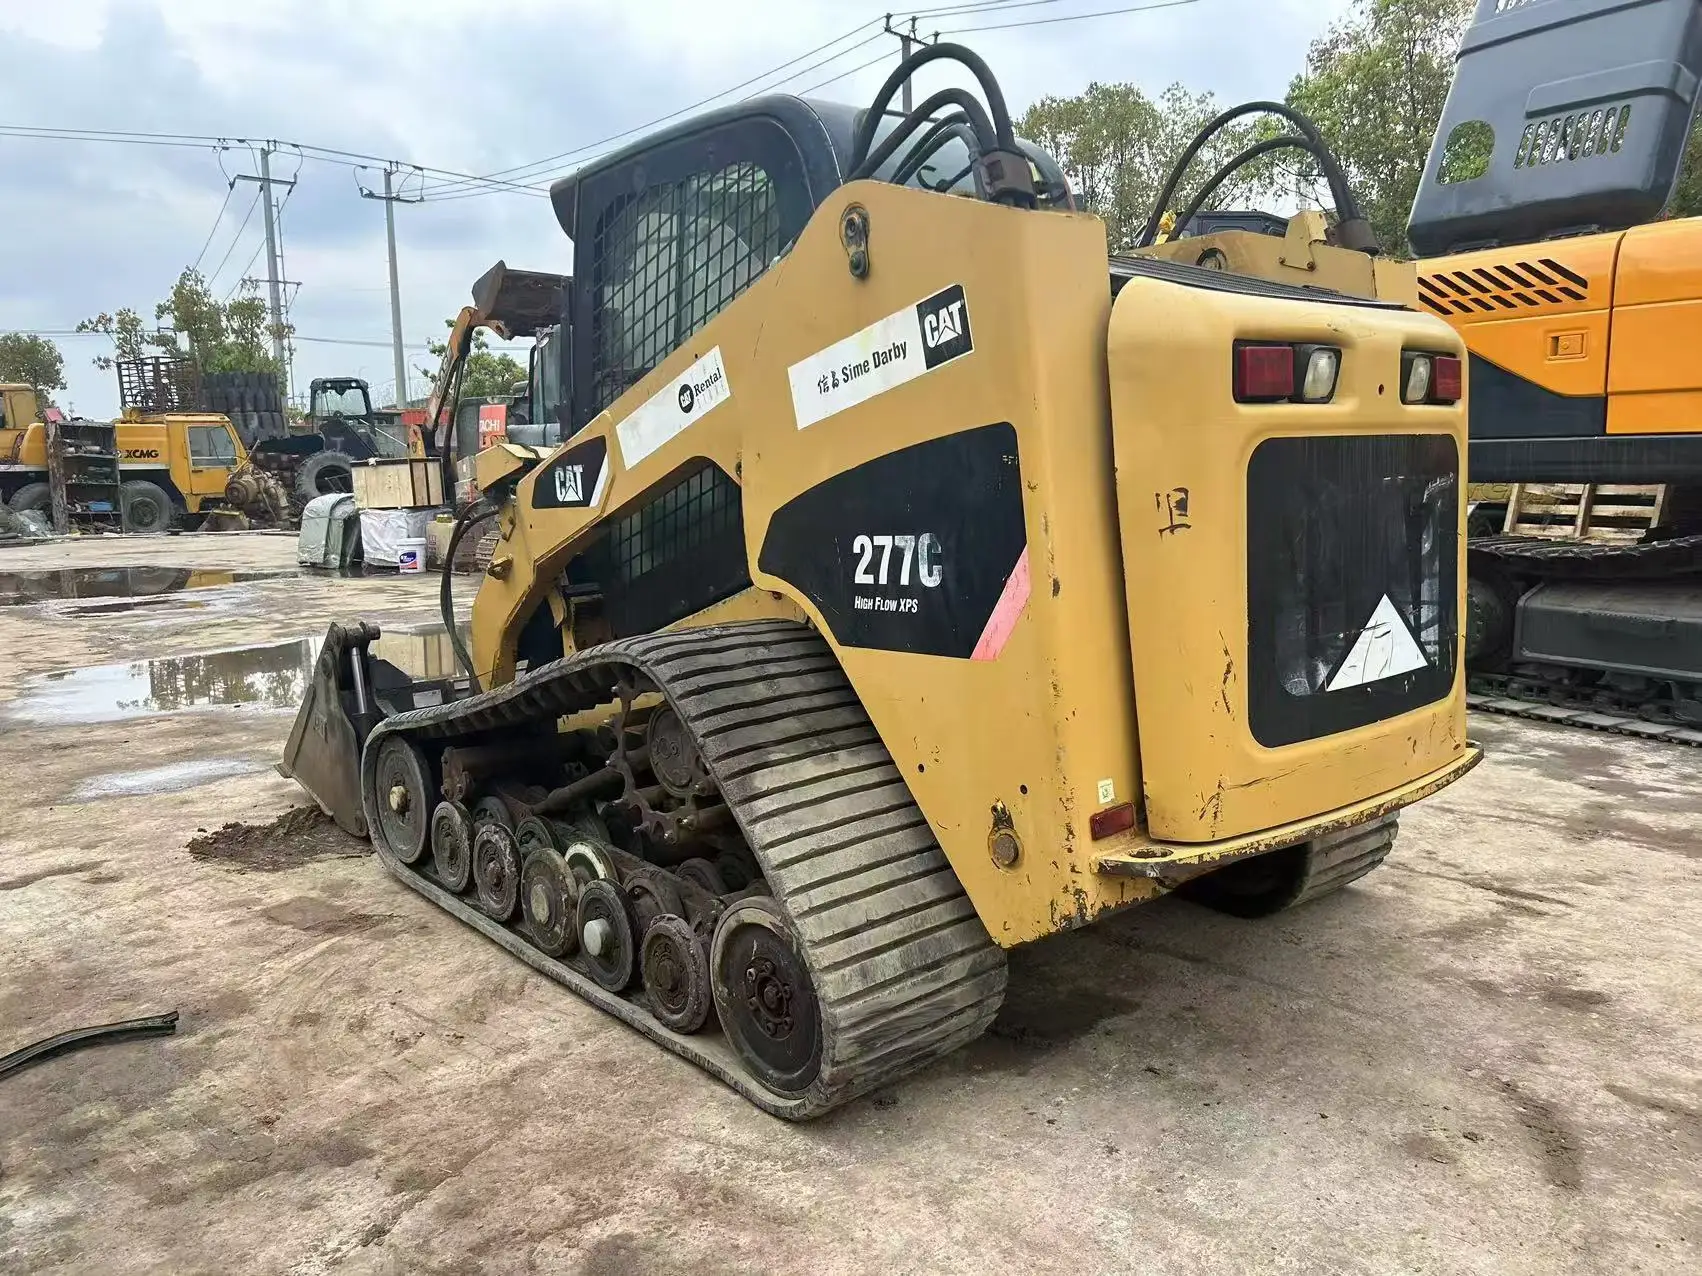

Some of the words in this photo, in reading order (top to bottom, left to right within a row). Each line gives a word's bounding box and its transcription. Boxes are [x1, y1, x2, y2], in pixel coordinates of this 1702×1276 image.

[924, 301, 963, 348] CAT
[842, 358, 870, 384] Sime
[872, 340, 908, 370] Darby
[693, 367, 722, 397] Rental
[124, 449, 160, 459] XCMG
[554, 464, 584, 502] CAT
[852, 532, 943, 588] 277C
[898, 598, 919, 614] XPS
